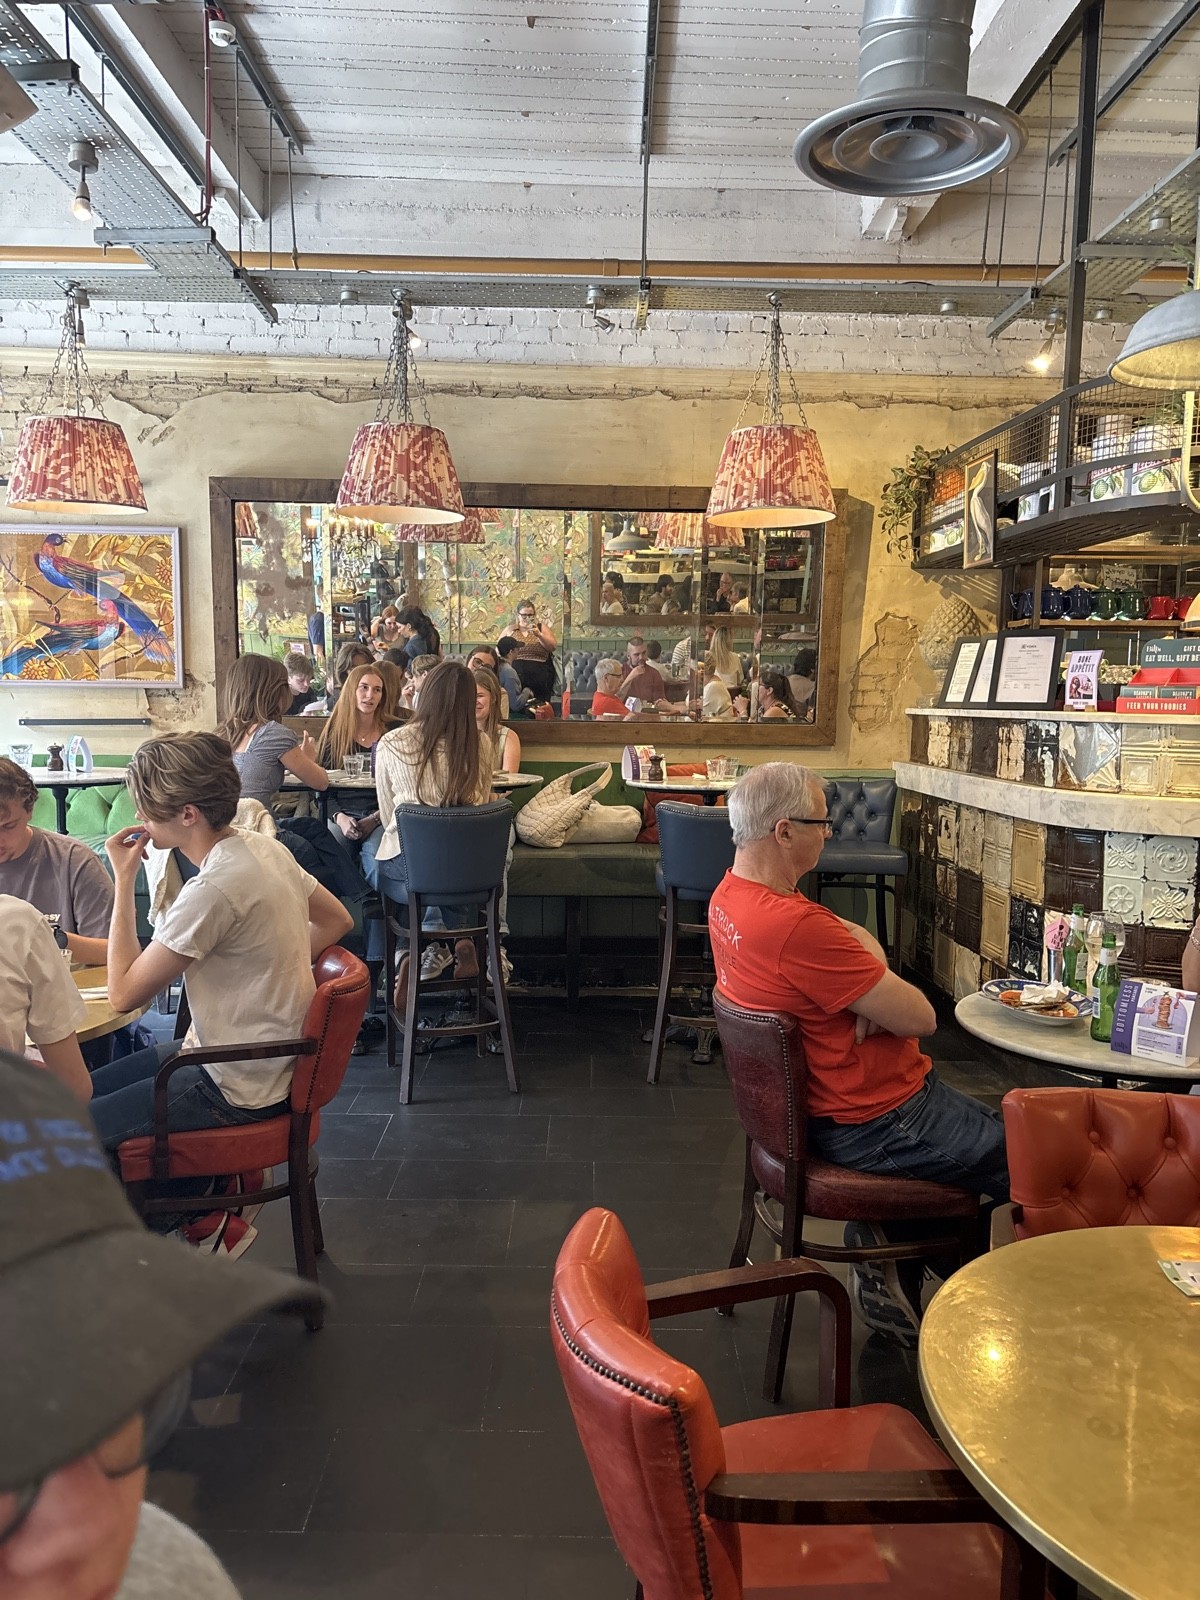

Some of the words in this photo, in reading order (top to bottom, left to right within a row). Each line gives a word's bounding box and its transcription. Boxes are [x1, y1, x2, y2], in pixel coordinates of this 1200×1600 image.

[1145, 654, 1156, 662] EAT
[1176, 654, 1190, 662] GIFT
[1126, 702, 1141, 710] FEED
[1143, 702, 1159, 710] YOUR
[1160, 703, 1187, 711] FOODIES
[1115, 984, 1133, 1033] BOTTOMLESS
